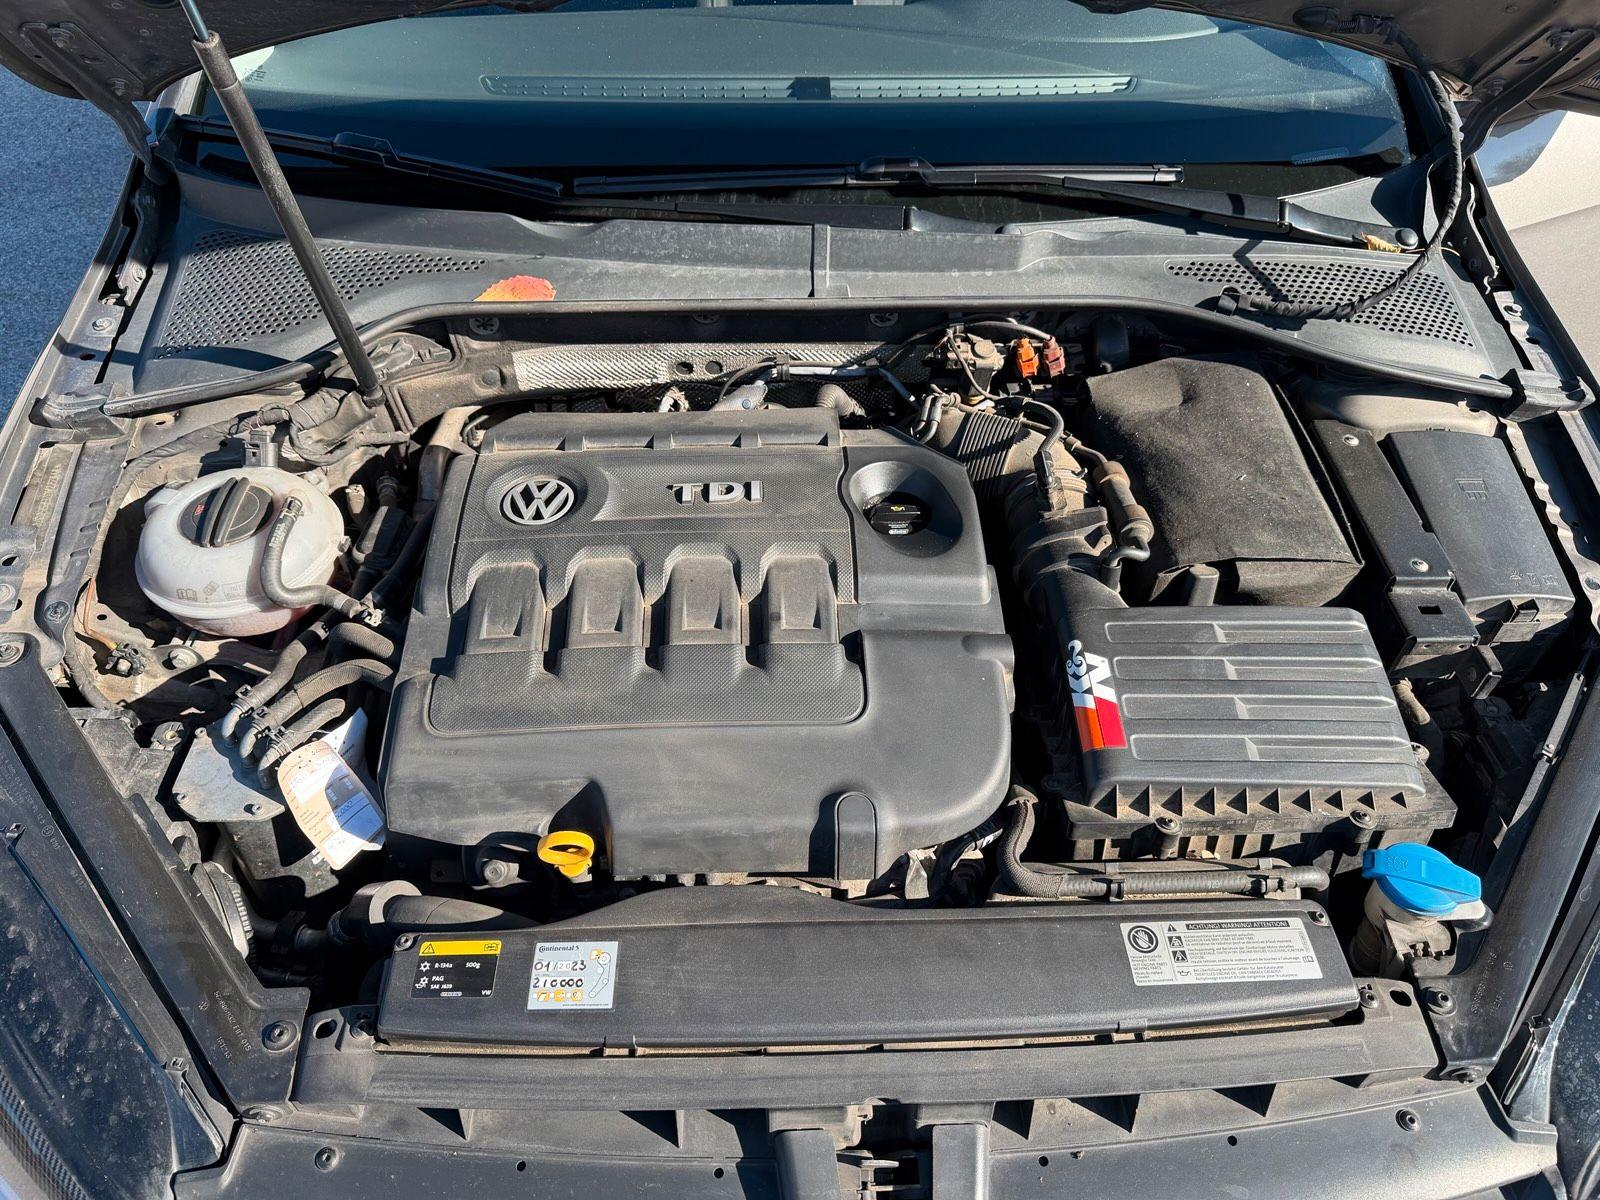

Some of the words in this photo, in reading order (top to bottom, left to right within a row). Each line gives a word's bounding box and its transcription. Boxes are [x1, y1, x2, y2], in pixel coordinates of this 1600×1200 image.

[671, 480, 764, 505] TDI
[1066, 640, 1118, 709] K&N
[1221, 922, 1252, 930] WARNING!
[1253, 920, 1288, 928] ATTENTION!
[538, 945, 575, 954] Continental
[465, 961, 481, 970] 500g
[431, 975, 445, 983] PAG
[532, 976, 585, 989] 210000
